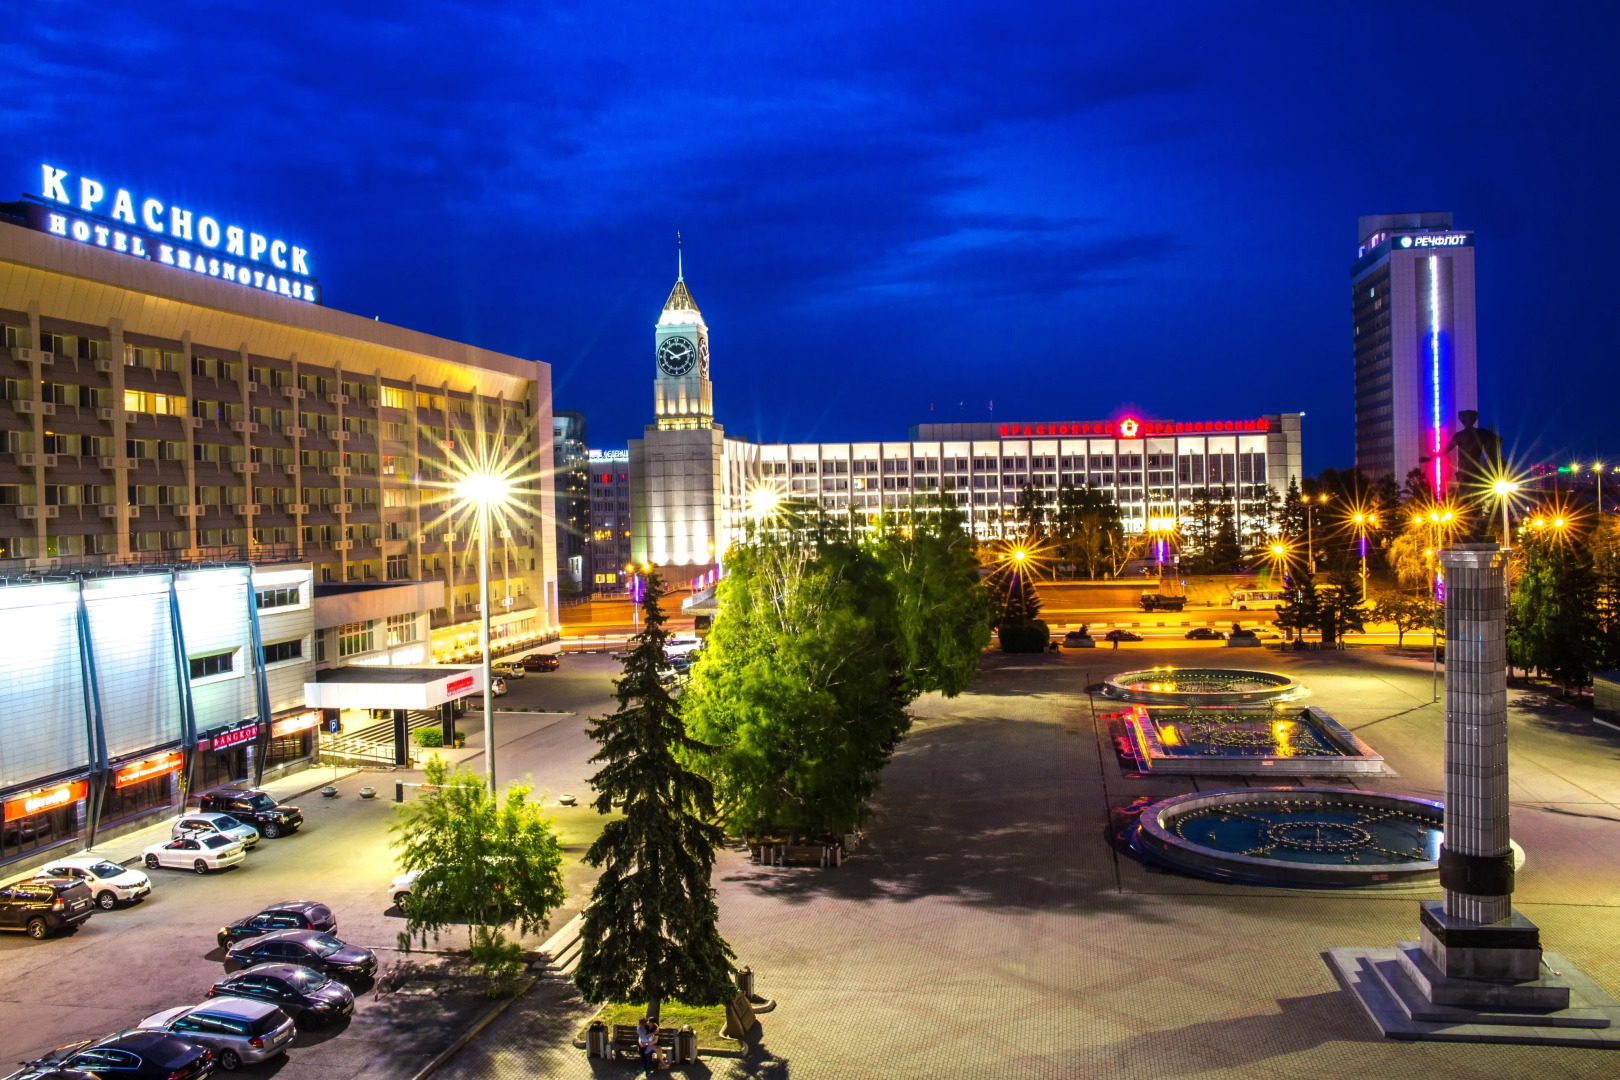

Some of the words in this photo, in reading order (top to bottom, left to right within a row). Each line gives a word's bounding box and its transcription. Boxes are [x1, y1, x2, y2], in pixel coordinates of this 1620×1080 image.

[41, 163, 309, 275] КРАСНОЯРСК
[1414, 235, 1467, 247] РЕЧФЛОТ
[49, 213, 146, 257] HOTEL
[158, 244, 316, 303] KRASNOYARSK
[1000, 423, 1112, 435] КРАСНОЯРСК
[1144, 417, 1269, 433] ОРДЕНОНОСНЫЙ
[213, 727, 257, 747] BANGKOK
